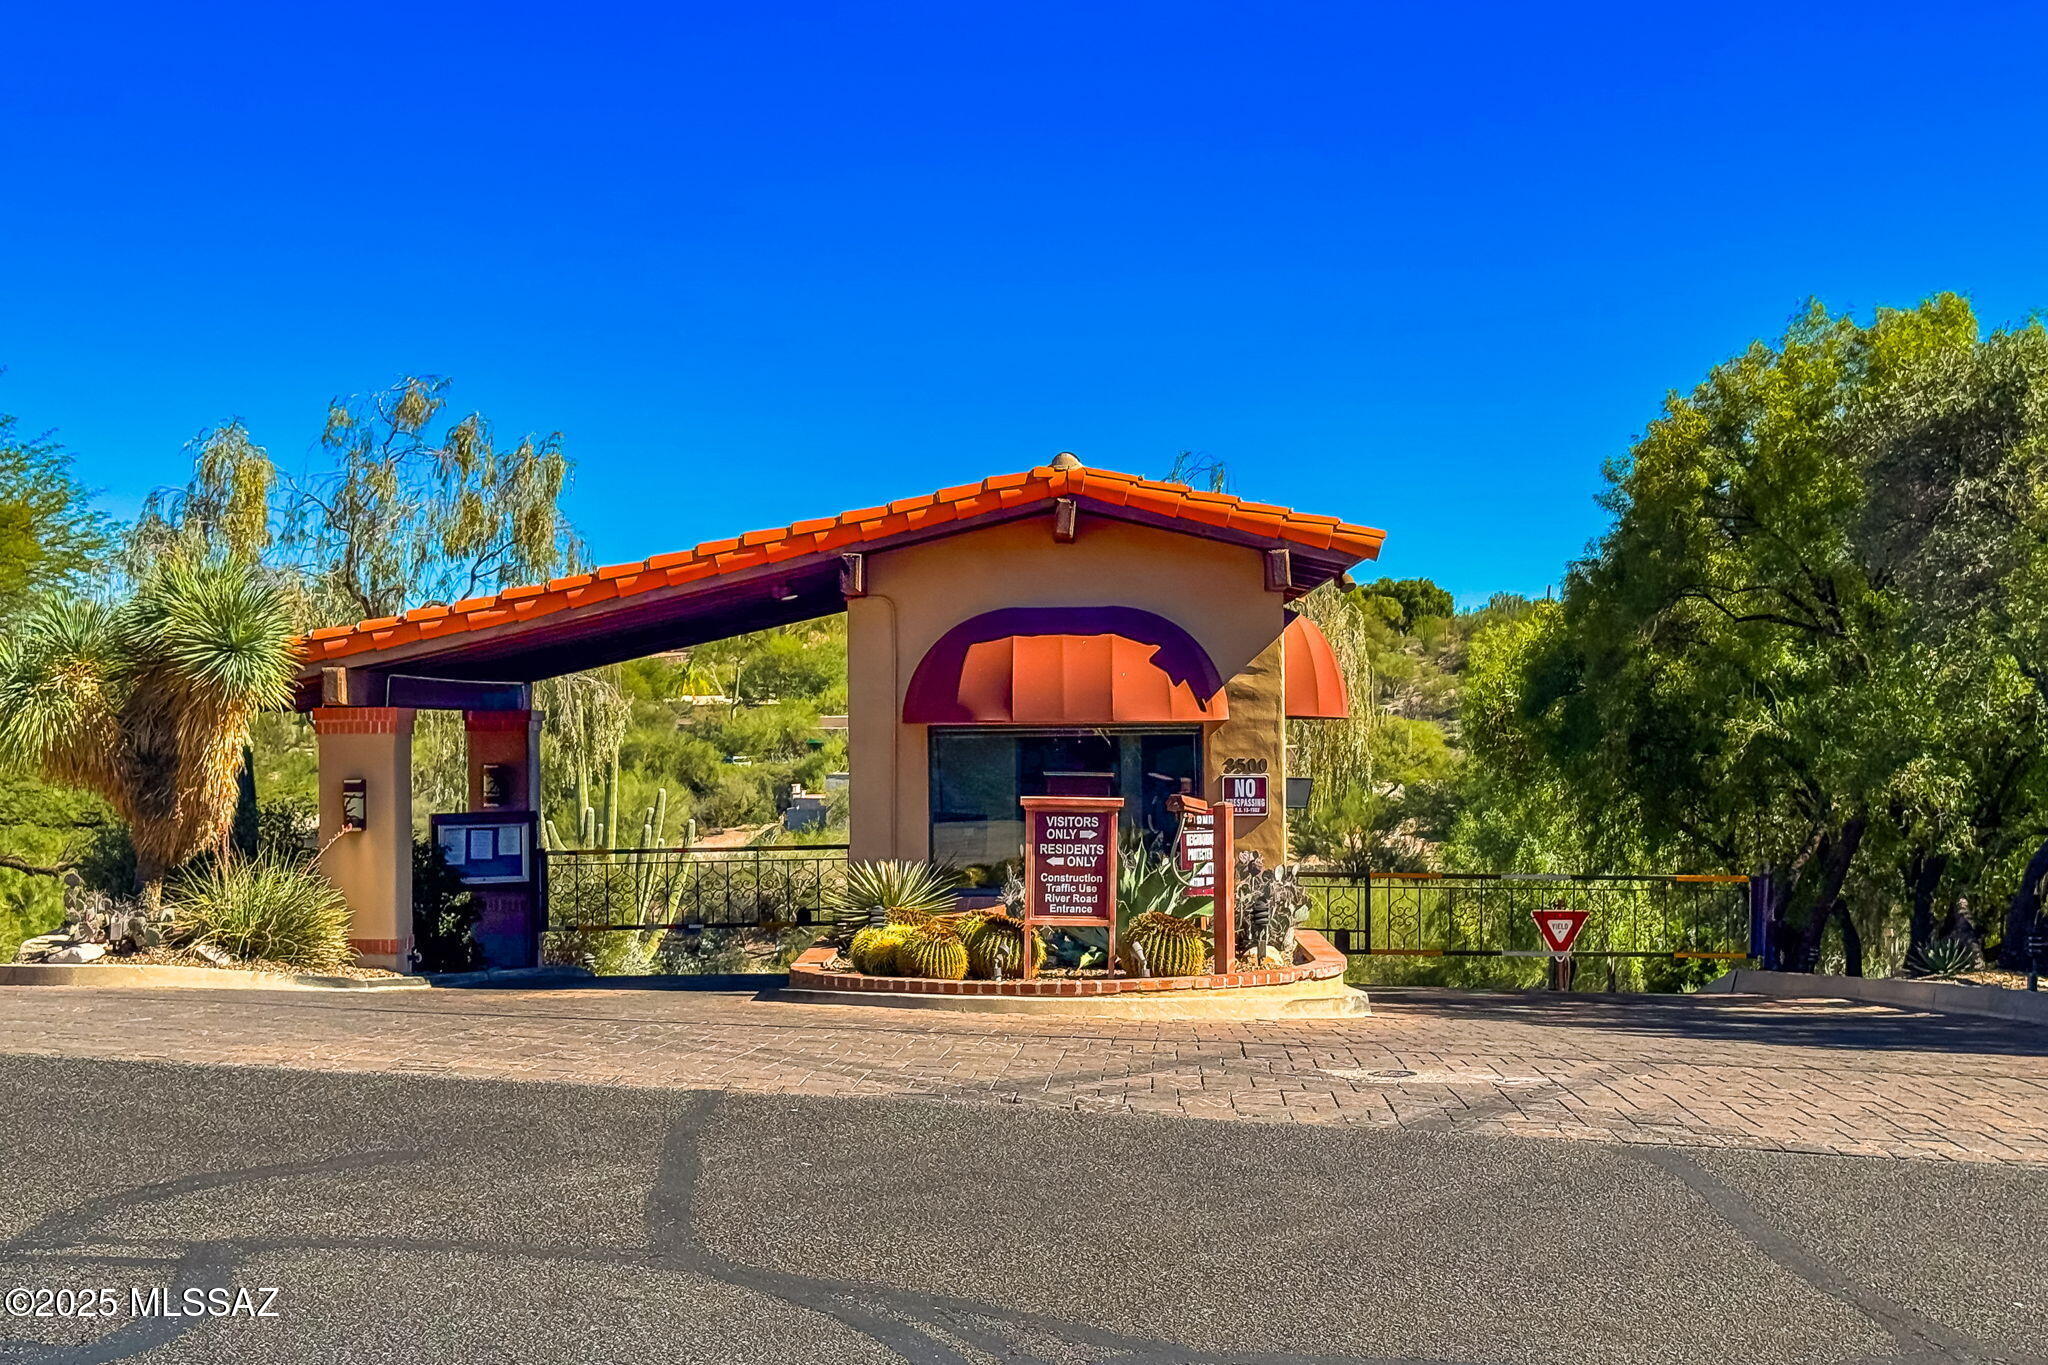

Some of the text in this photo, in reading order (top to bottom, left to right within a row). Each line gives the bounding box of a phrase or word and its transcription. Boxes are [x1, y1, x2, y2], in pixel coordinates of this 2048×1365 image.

[1235, 779, 1256, 798] NO
[1046, 816, 1099, 827] VISITORS
[1046, 829, 1077, 840] ONLY
[1040, 844, 1104, 855] RESIDENTS
[1066, 856, 1098, 867] ONLY
[1040, 873, 1103, 883] Construction
[1046, 884, 1097, 893] Traffic Use
[1045, 894, 1098, 903] River Road
[1049, 904, 1093, 914] Entrance
